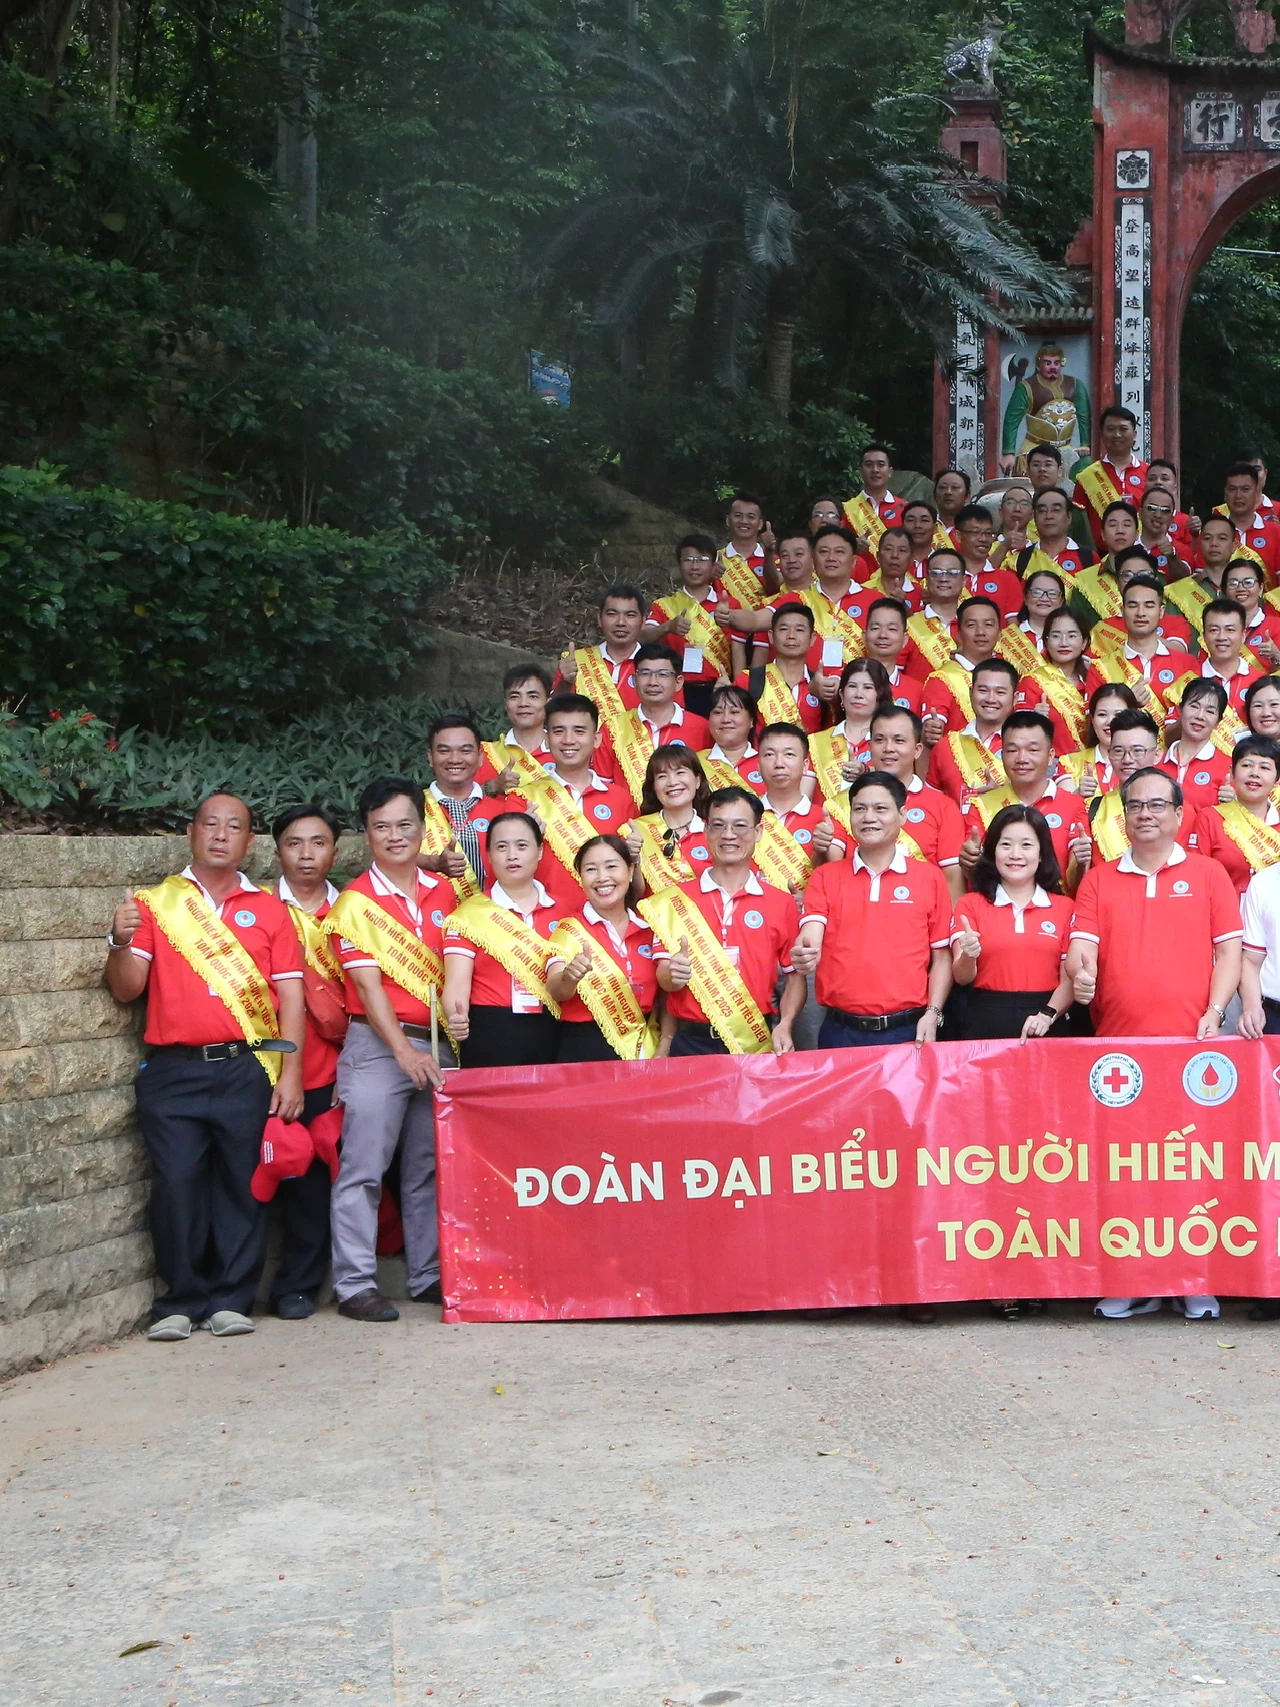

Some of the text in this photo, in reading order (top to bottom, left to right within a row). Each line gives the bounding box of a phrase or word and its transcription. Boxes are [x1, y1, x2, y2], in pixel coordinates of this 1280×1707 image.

[551, 818, 570, 839] TOÀN
[570, 819, 588, 839] MÁU
[764, 845, 783, 865] TOÀN
[781, 845, 800, 864] MÁU
[795, 861, 811, 881] TÌNH
[183, 895, 209, 921] NGƯỜI
[201, 920, 222, 940] HIẾN
[214, 938, 236, 959] MÁU
[229, 956, 250, 978] TÌNH
[362, 908, 441, 976] NGƯỜI HIẾN MÁU TÌNH
[489, 911, 533, 946] NGƯỜI HIẾN
[194, 937, 257, 1019] TOÀN QUỐC NĂM 2025
[386, 945, 431, 983] TOÀN QUỐC
[509, 943, 533, 966] TOÀN
[669, 893, 770, 1043] NGƯỜI HIẾN MÁU TÌNH NGUYỆN TIÊU BIỂU
[604, 971, 622, 992] TÌNH
[615, 991, 639, 1025] NGUYỆN
[689, 955, 733, 1018] QUỐC NĂM 2025
[601, 993, 629, 1036] NĂM 2025
[513, 1152, 664, 1208] ĐOÀN
[682, 1156, 771, 1209] ĐẠI
[792, 1128, 897, 1194] BIỂU
[918, 1132, 1088, 1187] NGƯỜI
[1110, 1124, 1223, 1181] HIẾN
[938, 1208, 1079, 1260] TOÀN
[1101, 1198, 1257, 1258] QUỐC
